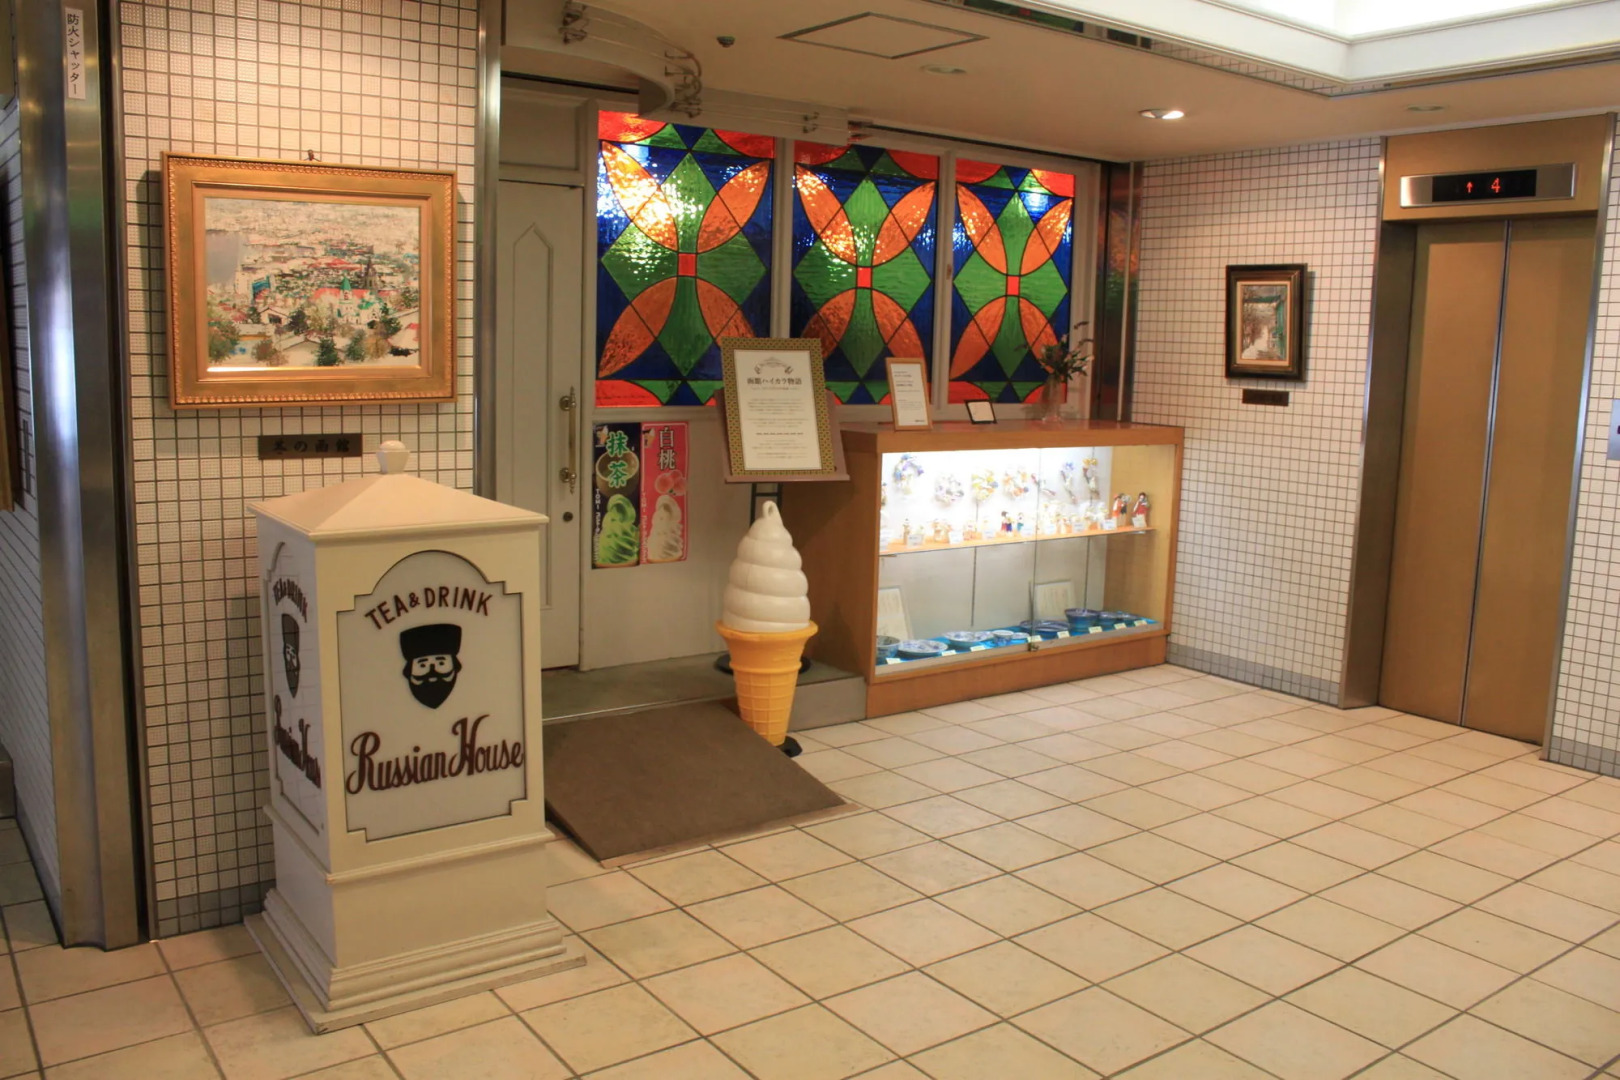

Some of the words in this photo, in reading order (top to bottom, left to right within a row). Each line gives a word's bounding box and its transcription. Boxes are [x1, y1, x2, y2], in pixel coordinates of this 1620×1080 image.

[67, 13, 80, 95] 防火シャッター
[1491, 178, 1501, 193] 4
[606, 430, 629, 488] 抹茶
[658, 426, 676, 470] 白桃
[346, 731, 449, 795] Russian
[449, 714, 524, 777] House
